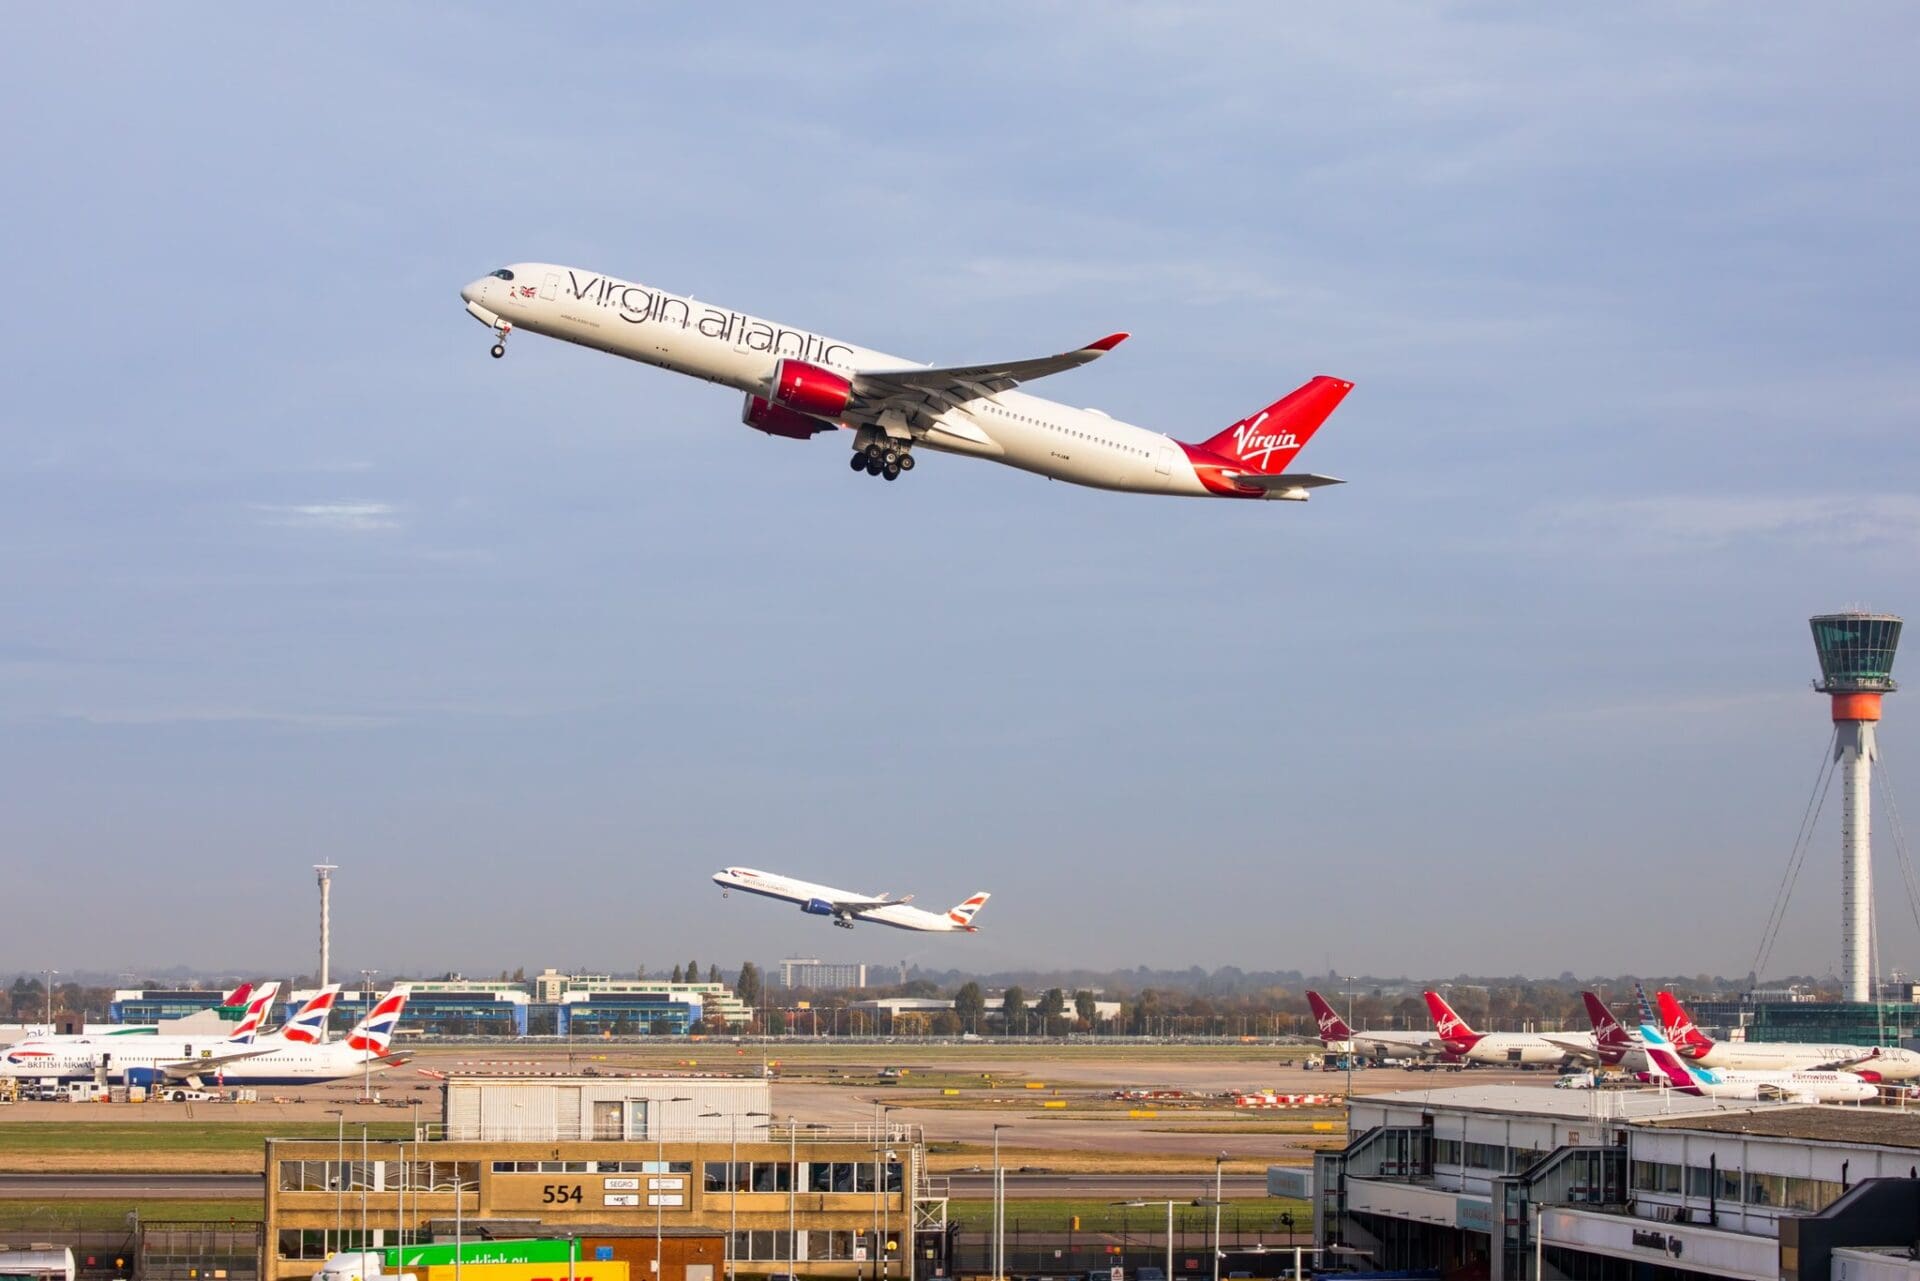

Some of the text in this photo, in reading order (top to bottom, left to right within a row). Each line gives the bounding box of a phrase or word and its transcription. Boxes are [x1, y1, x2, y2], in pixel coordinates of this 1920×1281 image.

[698, 308, 855, 365] atlantic
[1232, 411, 1301, 470] Virgin
[1666, 1016, 1698, 1044] Virgin
[27, 1060, 94, 1069] BRITISH AIRWA
[542, 1184, 584, 1204] 554
[609, 1180, 634, 1188] SEGRO
